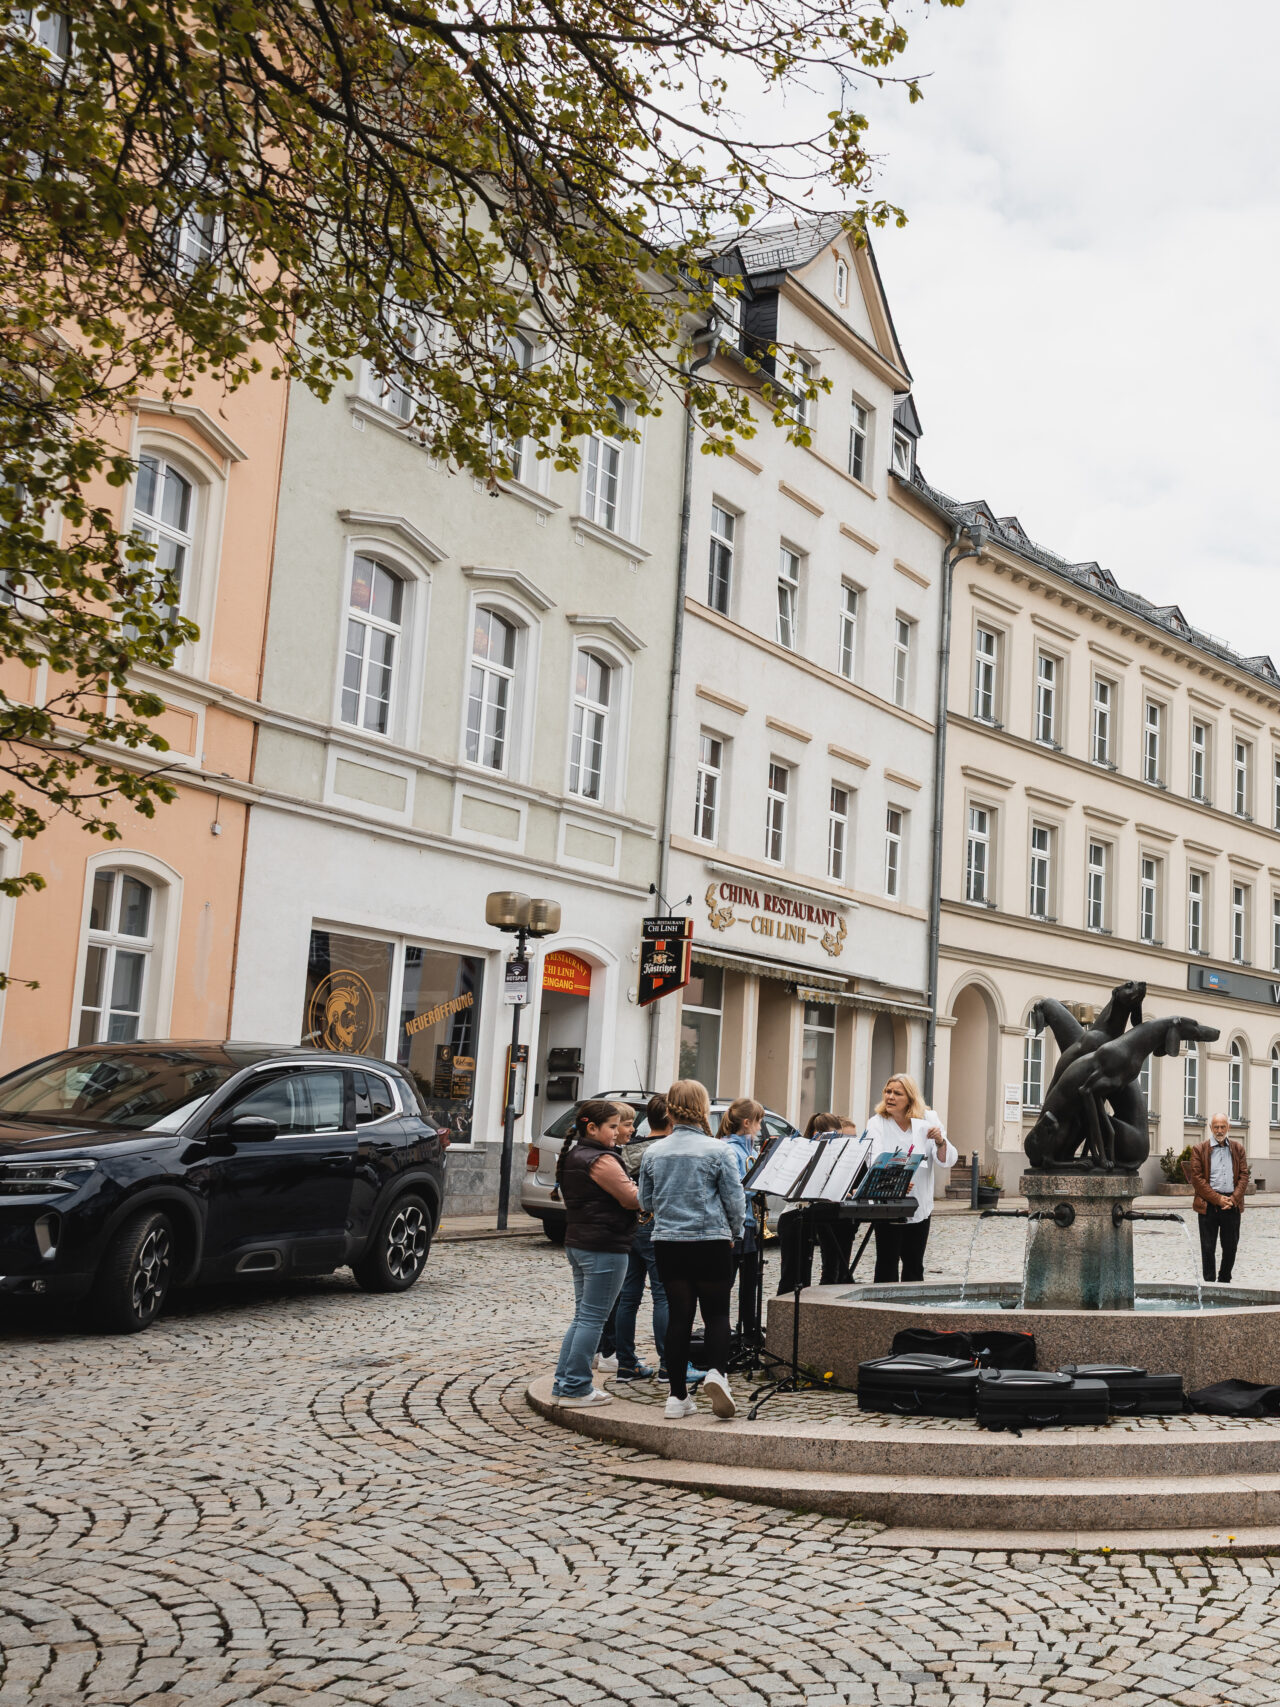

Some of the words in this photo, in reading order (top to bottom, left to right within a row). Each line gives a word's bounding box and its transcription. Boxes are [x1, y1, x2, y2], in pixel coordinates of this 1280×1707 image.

[719, 882, 760, 908] CHINA
[763, 893, 837, 927] RESTAURANT
[750, 915, 774, 937] CHI
[776, 921, 807, 944] LINH
[550, 953, 587, 977] RESTAURANT
[557, 967, 574, 978] LINH
[543, 976, 574, 990] EINGANG
[405, 991, 474, 1036] NEUERÖFFNUNG
